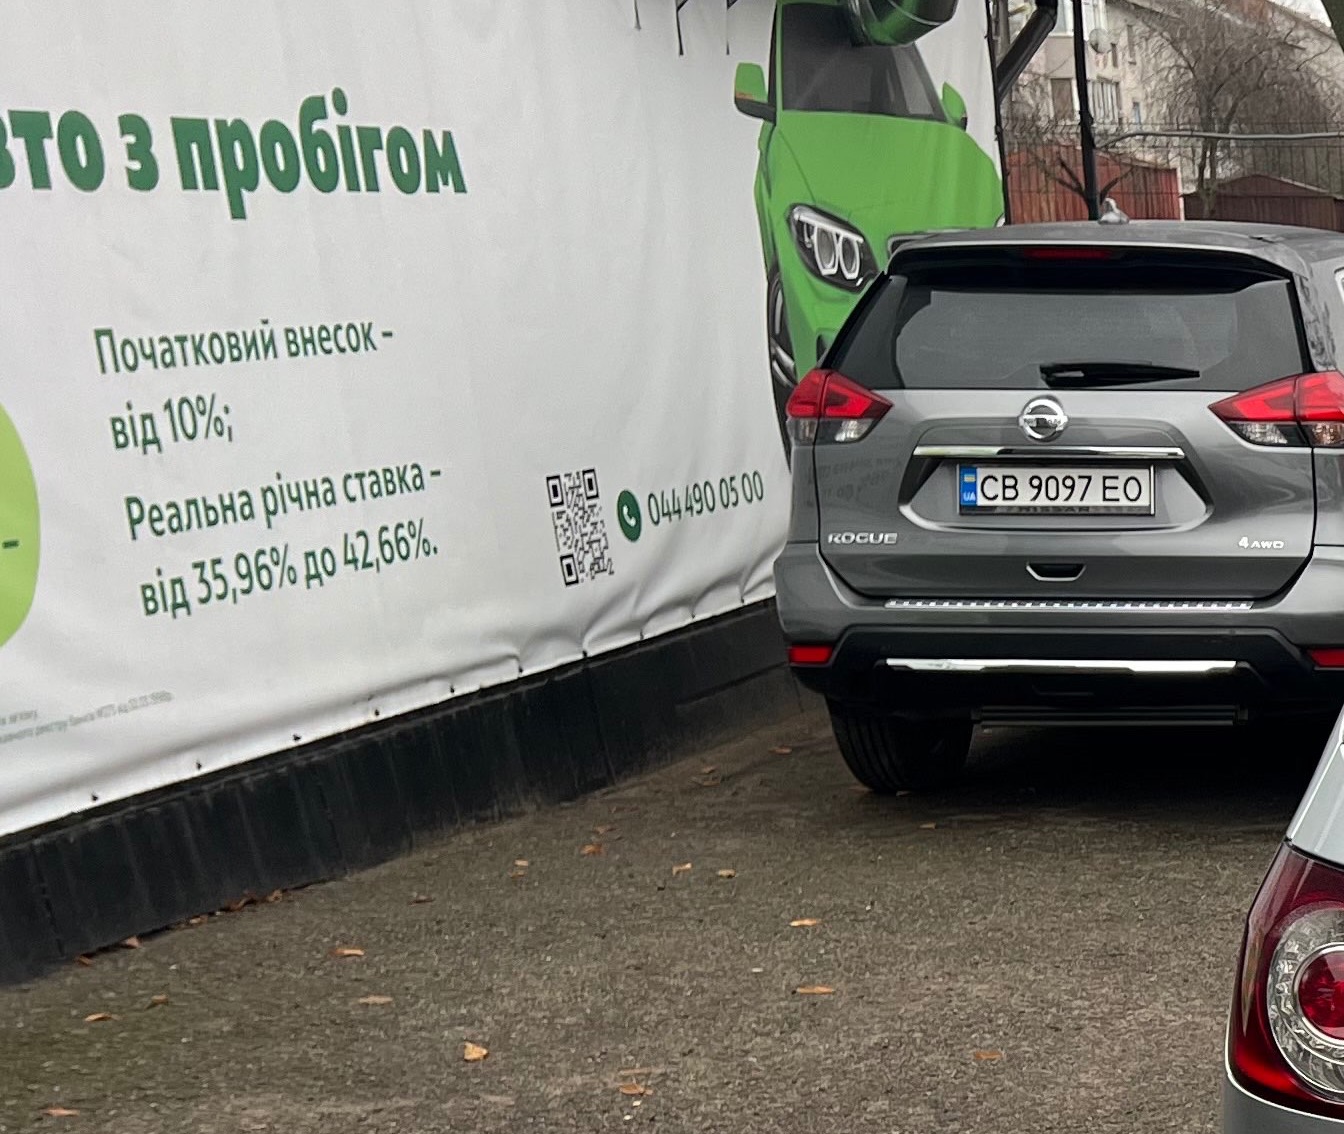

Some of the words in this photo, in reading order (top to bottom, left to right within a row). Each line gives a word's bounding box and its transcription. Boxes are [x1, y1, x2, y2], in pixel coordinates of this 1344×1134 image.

[118, 113, 160, 192] з
[170, 87, 468, 220] пробігом
[93, 318, 279, 375] Початковий
[284, 321, 378, 358] внесок
[109, 400, 163, 454] від
[163, 393, 234, 442] 10%;
[123, 488, 255, 541] Реальна
[260, 471, 338, 529] річна
[342, 462, 425, 503] ставка
[647, 487, 682, 526] 044
[684, 480, 716, 517] 490
[719, 475, 739, 509] 05
[741, 470, 764, 504] 00
[980, 474, 1019, 501] CB
[1028, 474, 1092, 502] 9097
[1101, 475, 1142, 502] EO
[827, 532, 898, 544] ROGUE
[139, 567, 192, 620] від
[191, 543, 298, 605] 35,96%
[303, 546, 337, 590] до
[343, 517, 439, 574] 42,66%.
